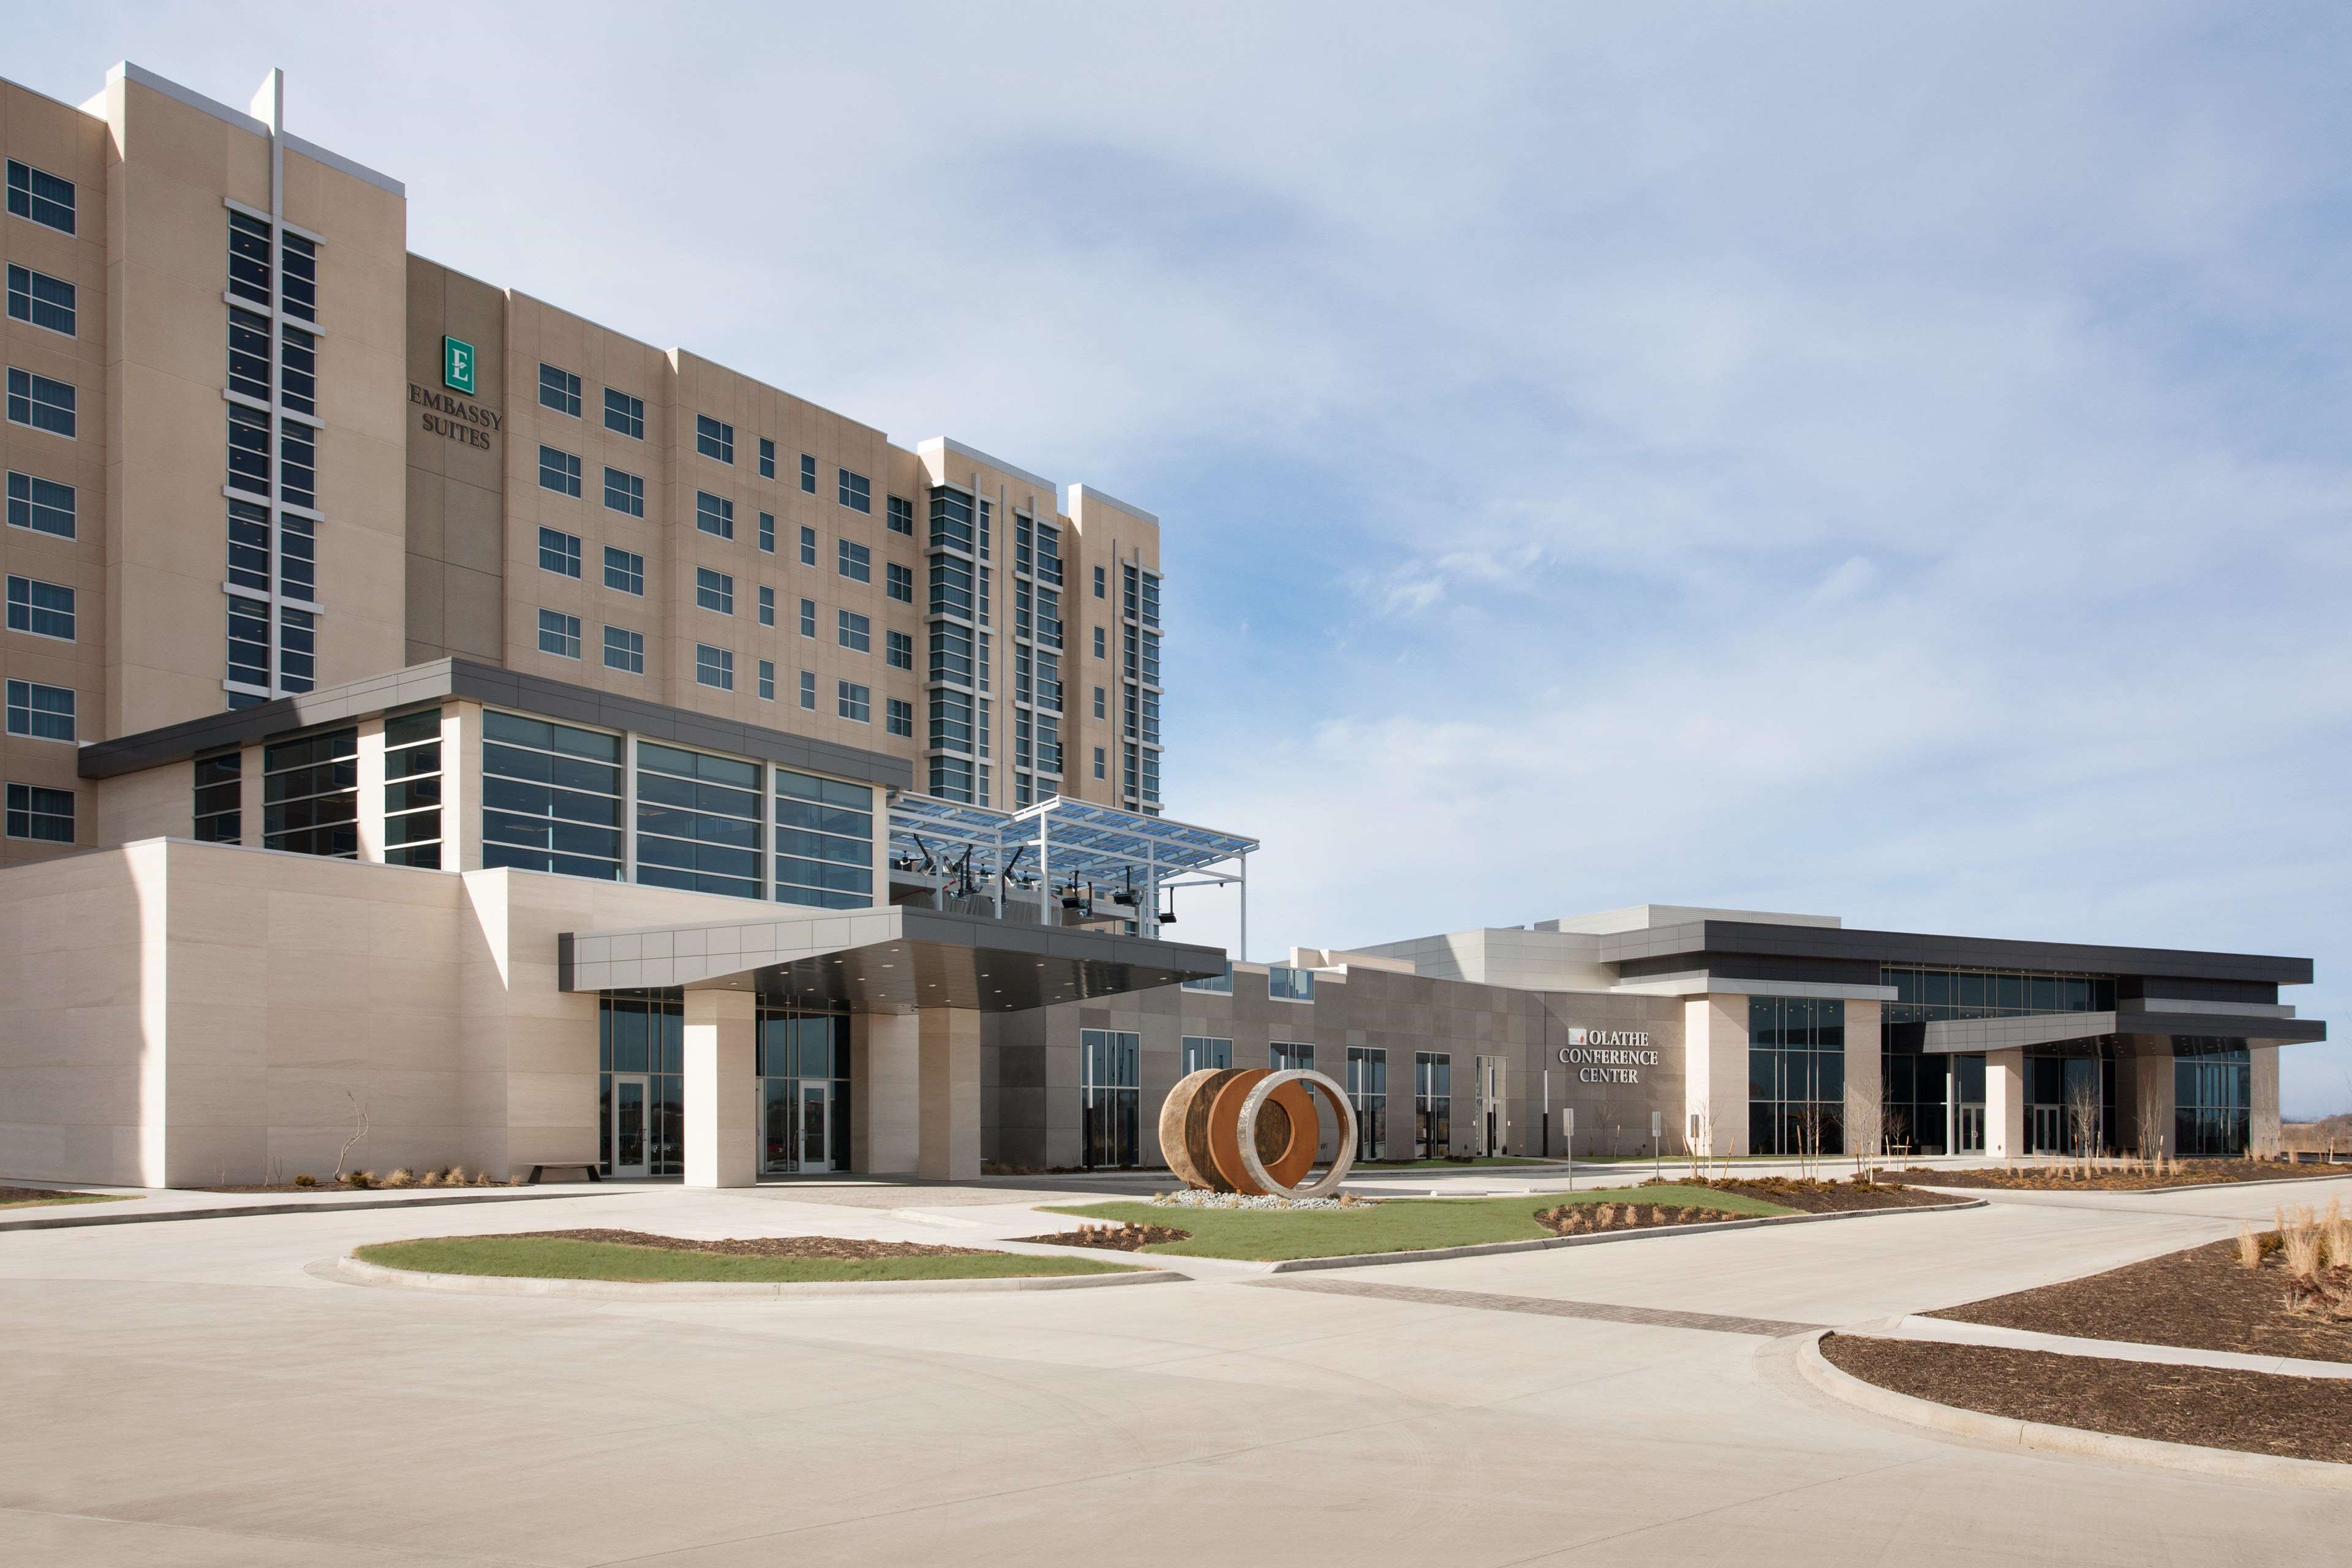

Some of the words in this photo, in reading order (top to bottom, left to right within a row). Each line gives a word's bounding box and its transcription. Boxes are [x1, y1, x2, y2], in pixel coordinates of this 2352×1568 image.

[451, 348, 469, 382] E
[409, 383, 502, 431] EMBASSY
[422, 413, 491, 450] SUITES
[1589, 1030, 1649, 1046] OLATHE
[1559, 1049, 1658, 1065] CONFERENCE
[1580, 1068, 1638, 1083] CENTER
